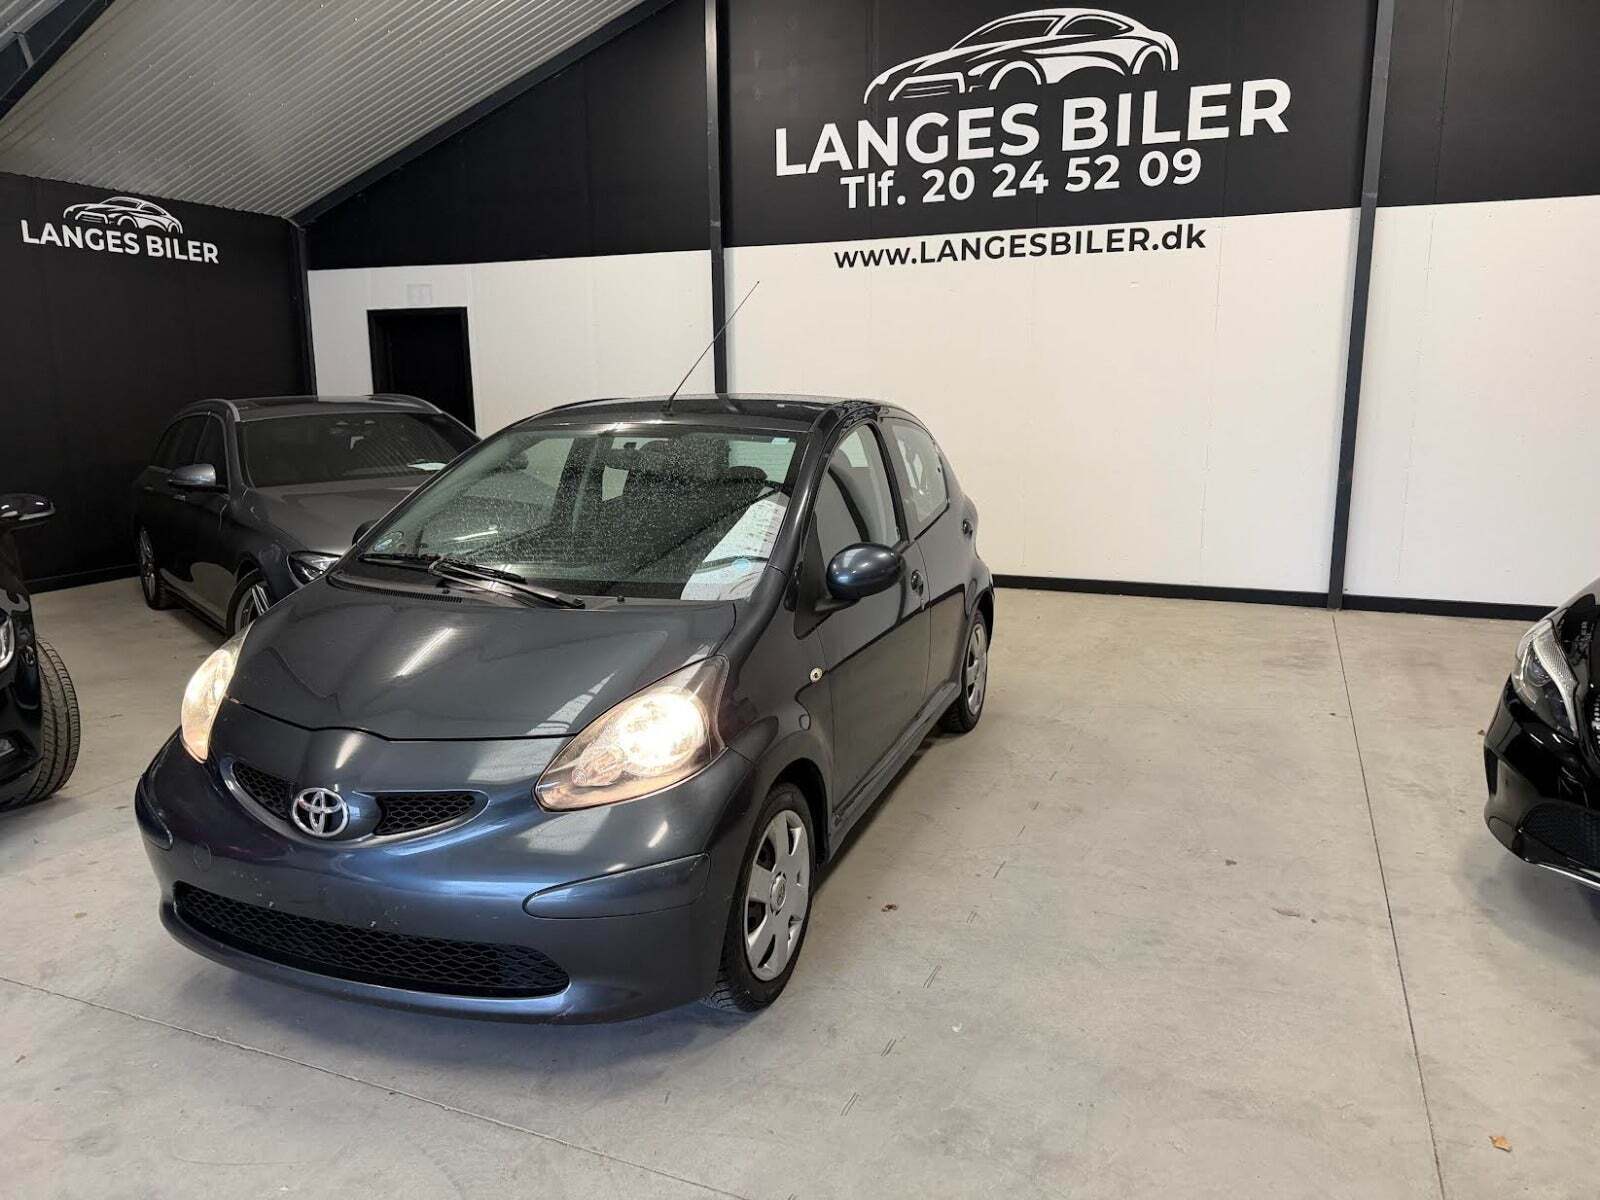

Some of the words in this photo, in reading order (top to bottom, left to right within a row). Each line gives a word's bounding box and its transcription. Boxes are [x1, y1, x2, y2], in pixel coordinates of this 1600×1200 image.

[775, 102, 1040, 177] LANGES
[1061, 78, 1292, 152] BILER
[839, 169, 906, 209] Tlf.
[921, 167, 975, 204] 20
[991, 160, 1049, 198] 24
[1064, 155, 1120, 192] 52
[1138, 147, 1202, 187] 09
[20, 219, 140, 256] LANGES
[145, 234, 219, 264] BILER
[833, 223, 1206, 269] www.LANGESBILER.dk
